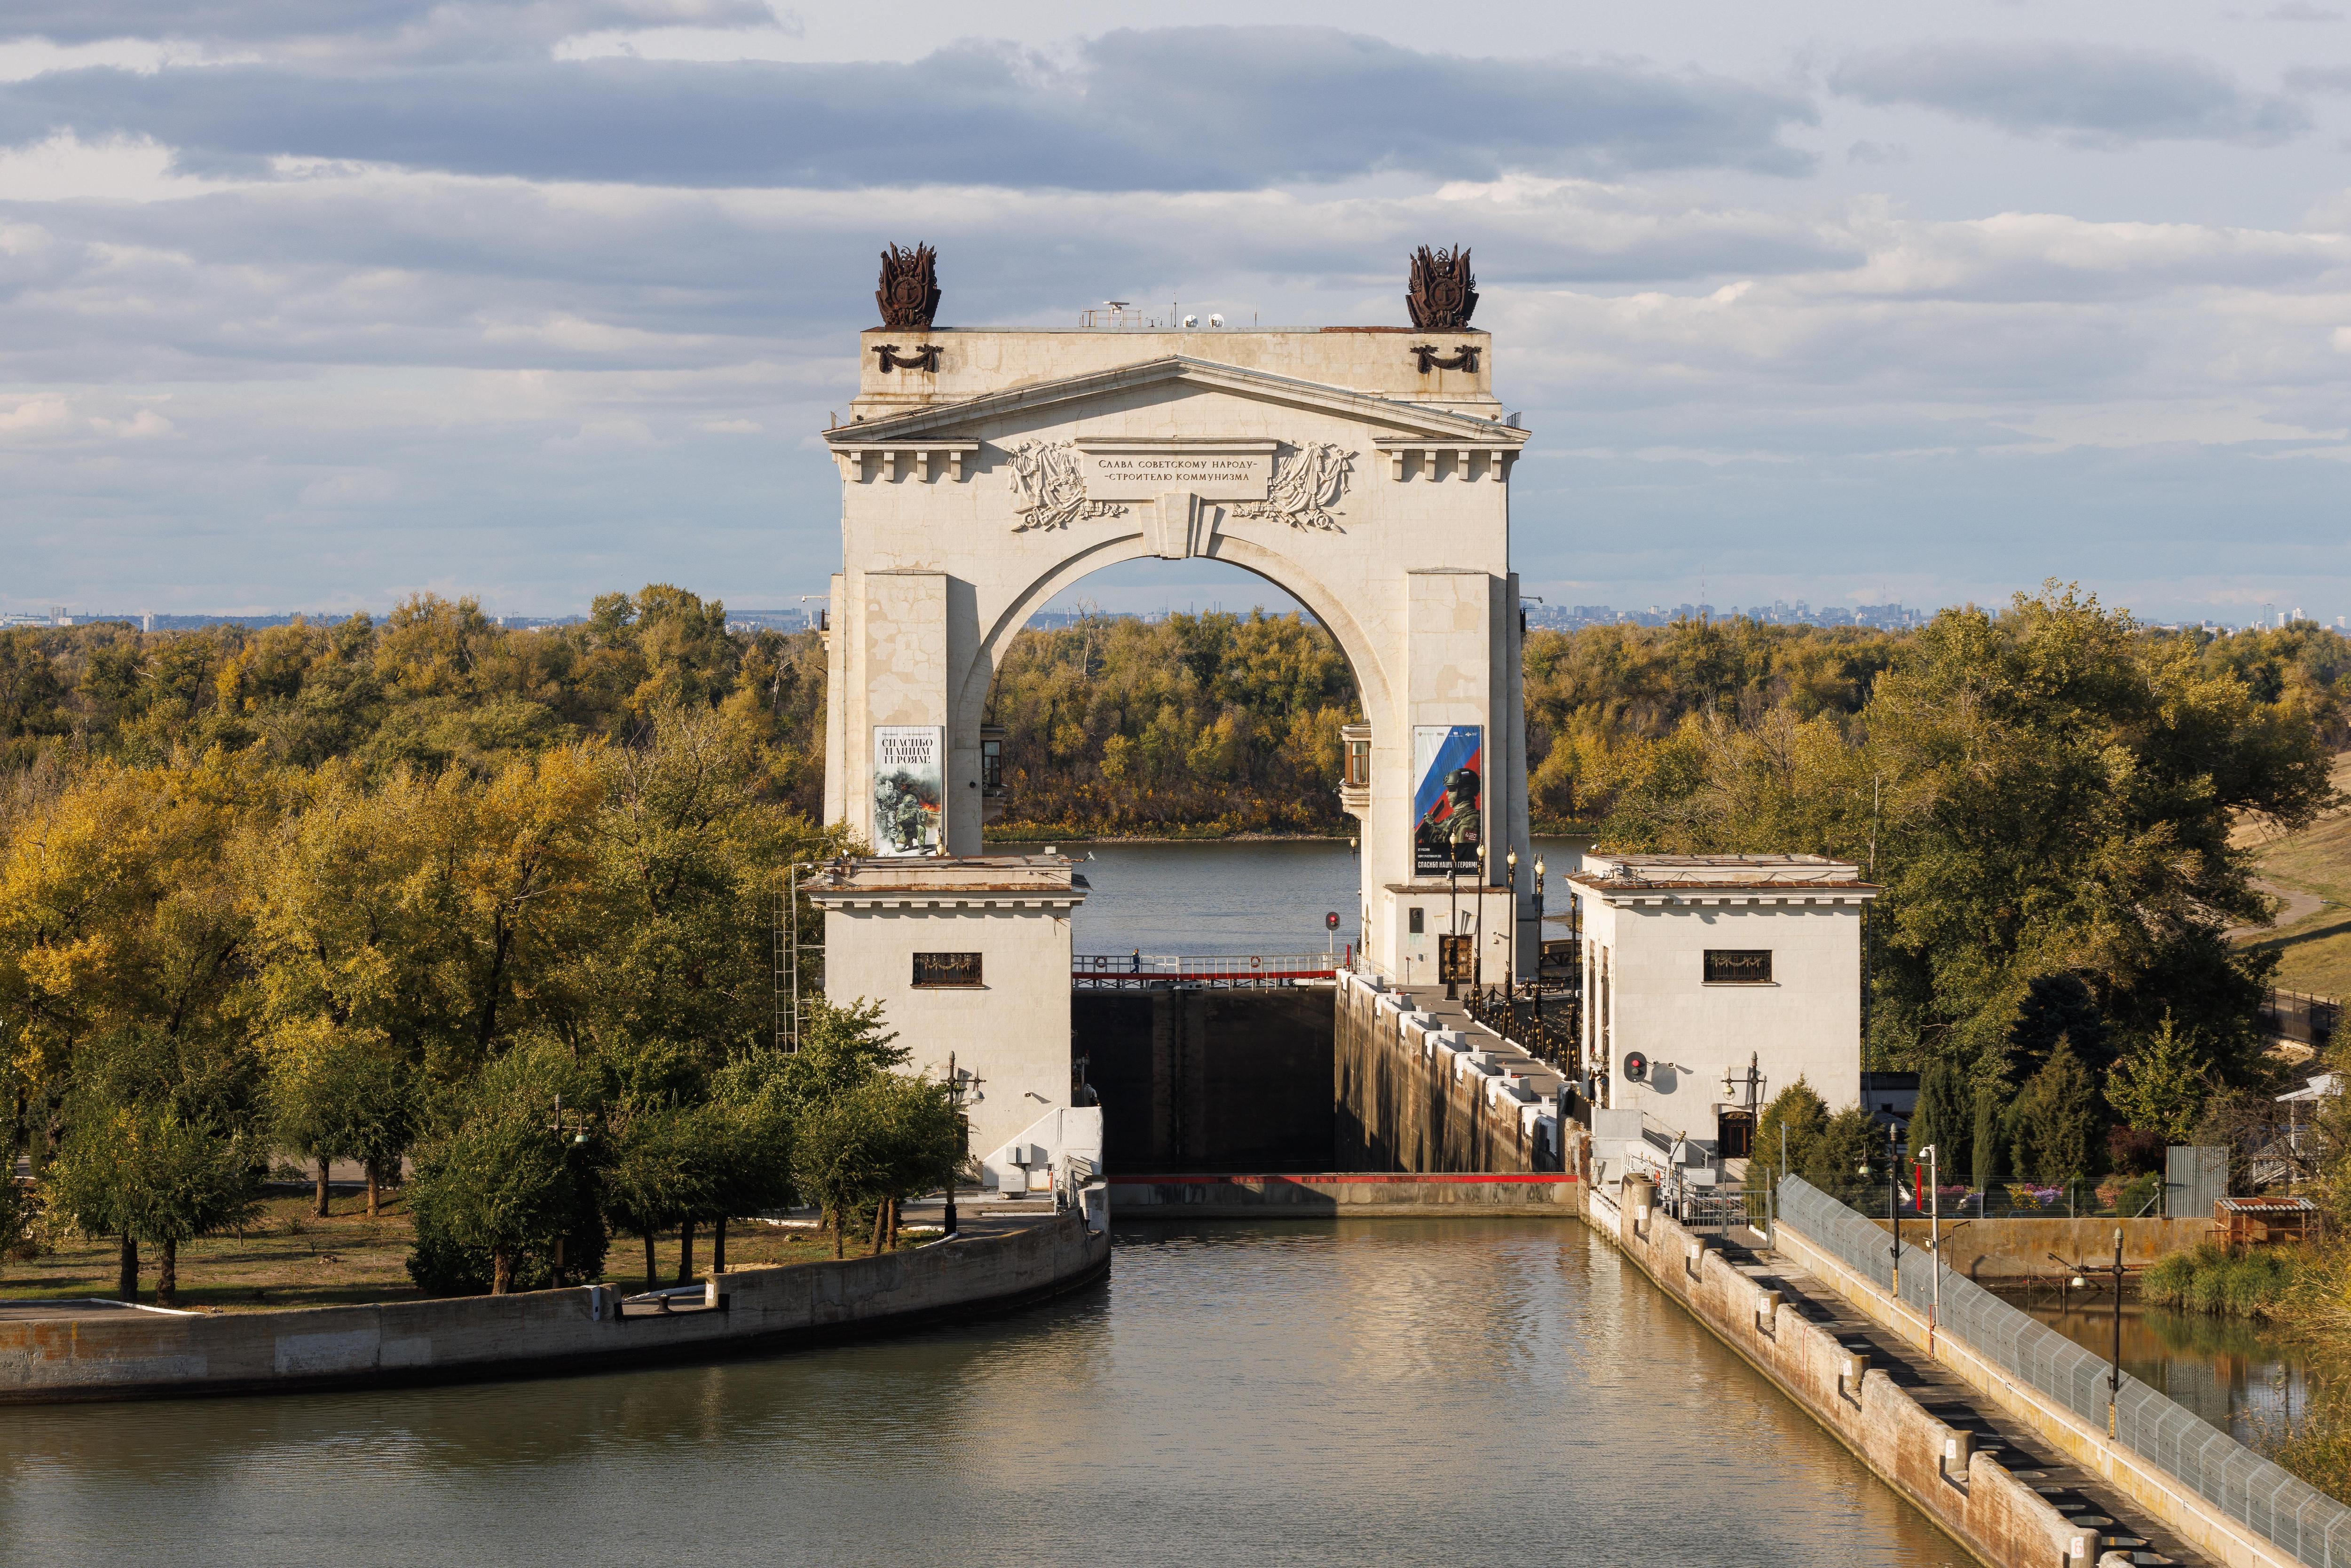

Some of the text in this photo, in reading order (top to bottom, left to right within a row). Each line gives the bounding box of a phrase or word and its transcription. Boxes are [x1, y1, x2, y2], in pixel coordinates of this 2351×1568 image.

[1641, 1208, 1645, 1216] 1
[1694, 1247, 1698, 1257] 2
[708, 1286, 712, 1295] 2
[1762, 1300, 1768, 1311] 3
[1948, 1443, 1955, 1456] 5
[2075, 1541, 2083, 1554] 6
